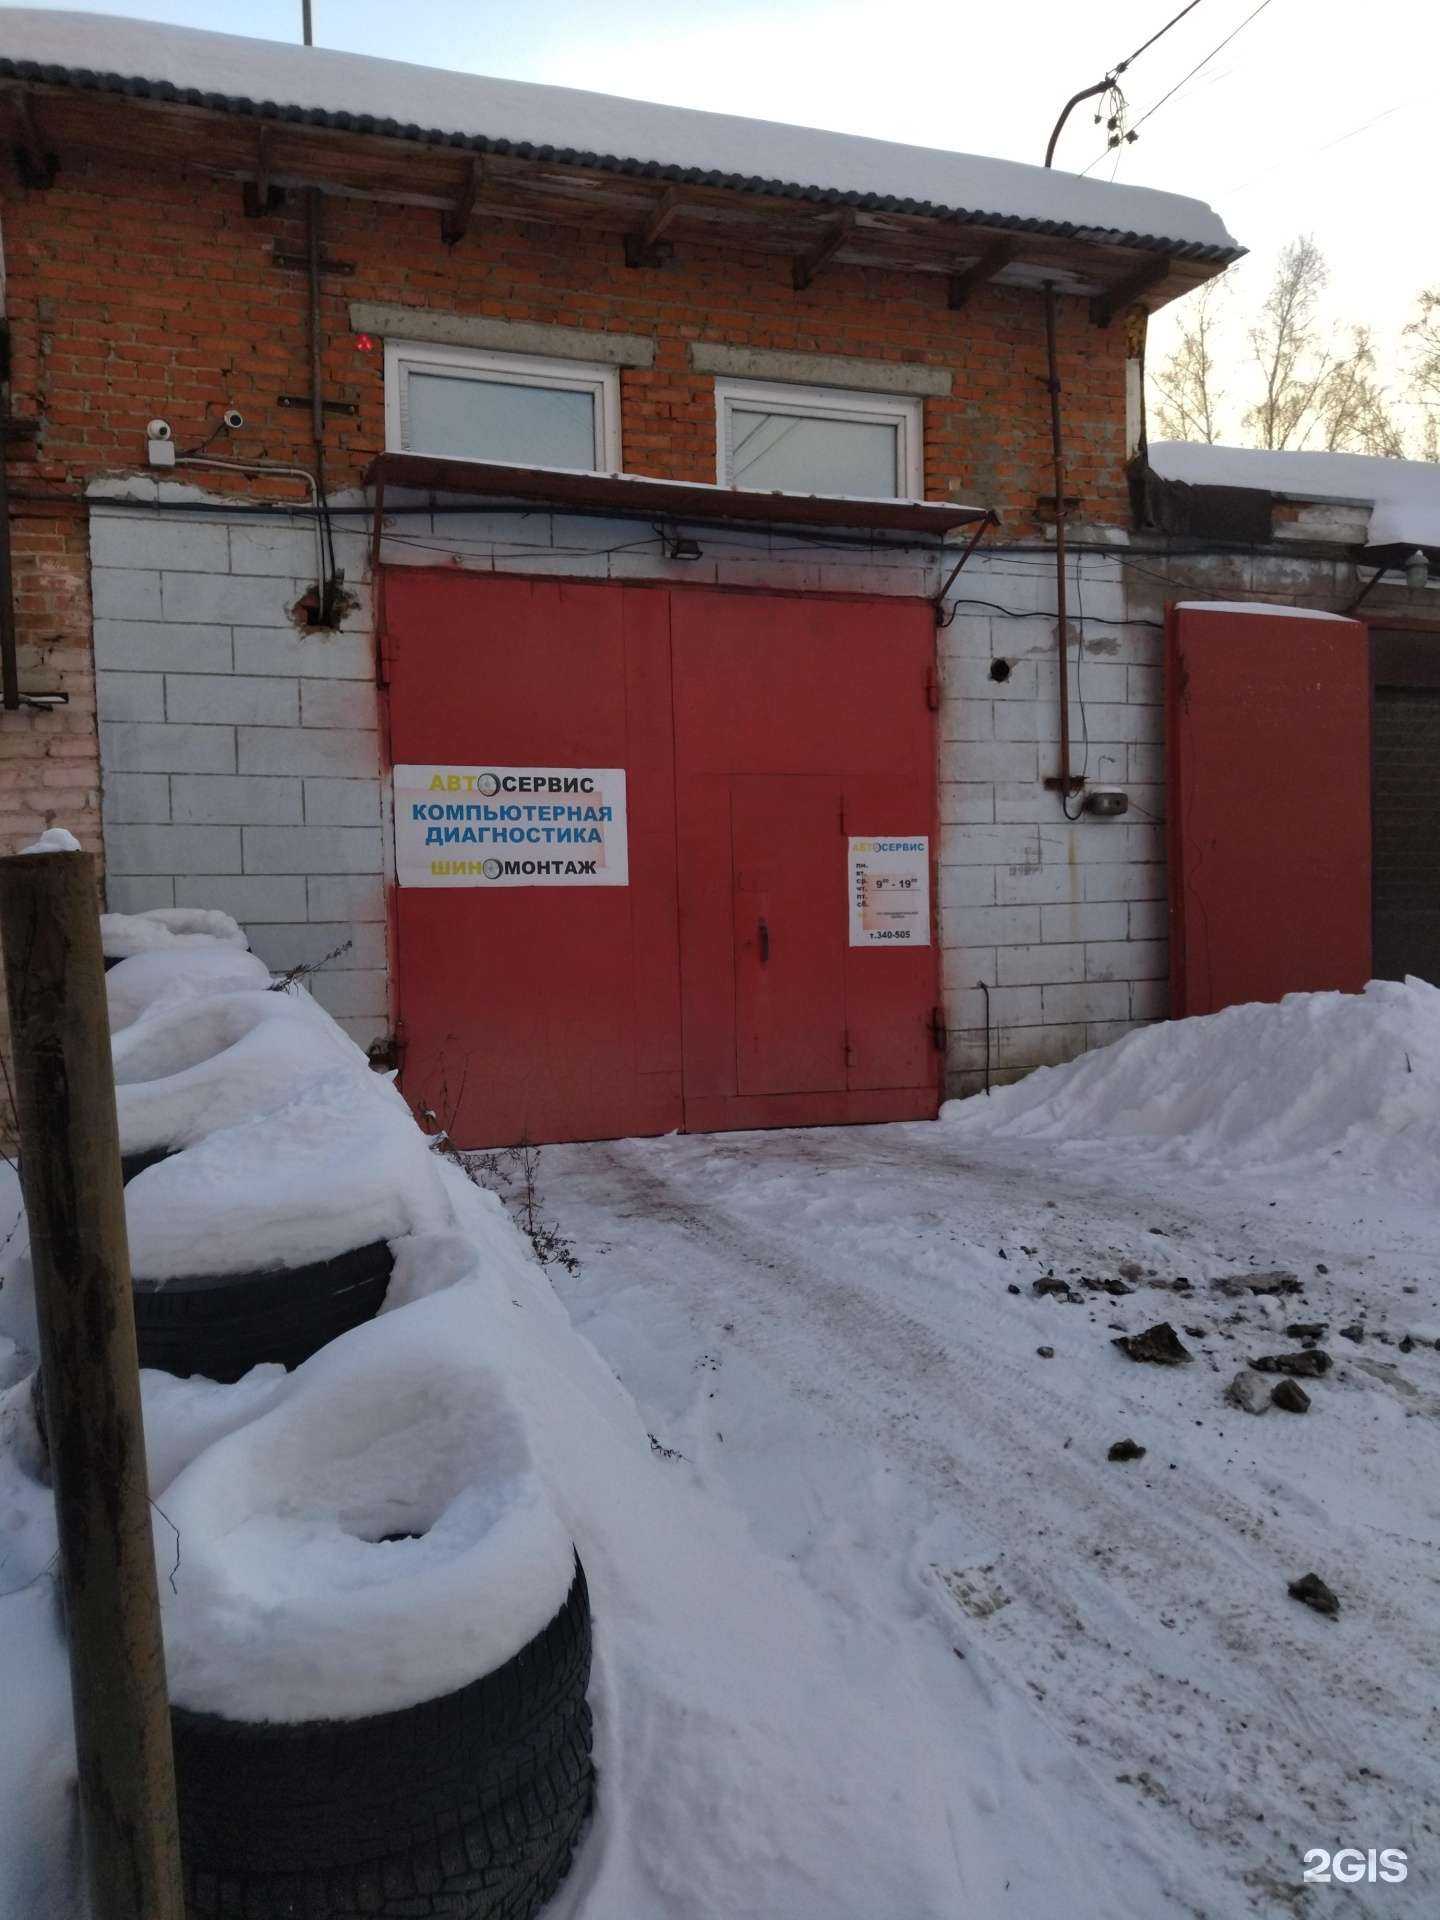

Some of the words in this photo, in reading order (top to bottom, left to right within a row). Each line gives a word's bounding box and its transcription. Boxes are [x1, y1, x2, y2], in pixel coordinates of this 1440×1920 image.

[429, 773, 595, 797] АВТОСЕРВИС
[412, 804, 613, 822] КОМПЬЮТЕРНАЯ
[425, 827, 602, 846] ДИАГНОСТИКА
[431, 858, 596, 880] ШИНОМОНТАЖ
